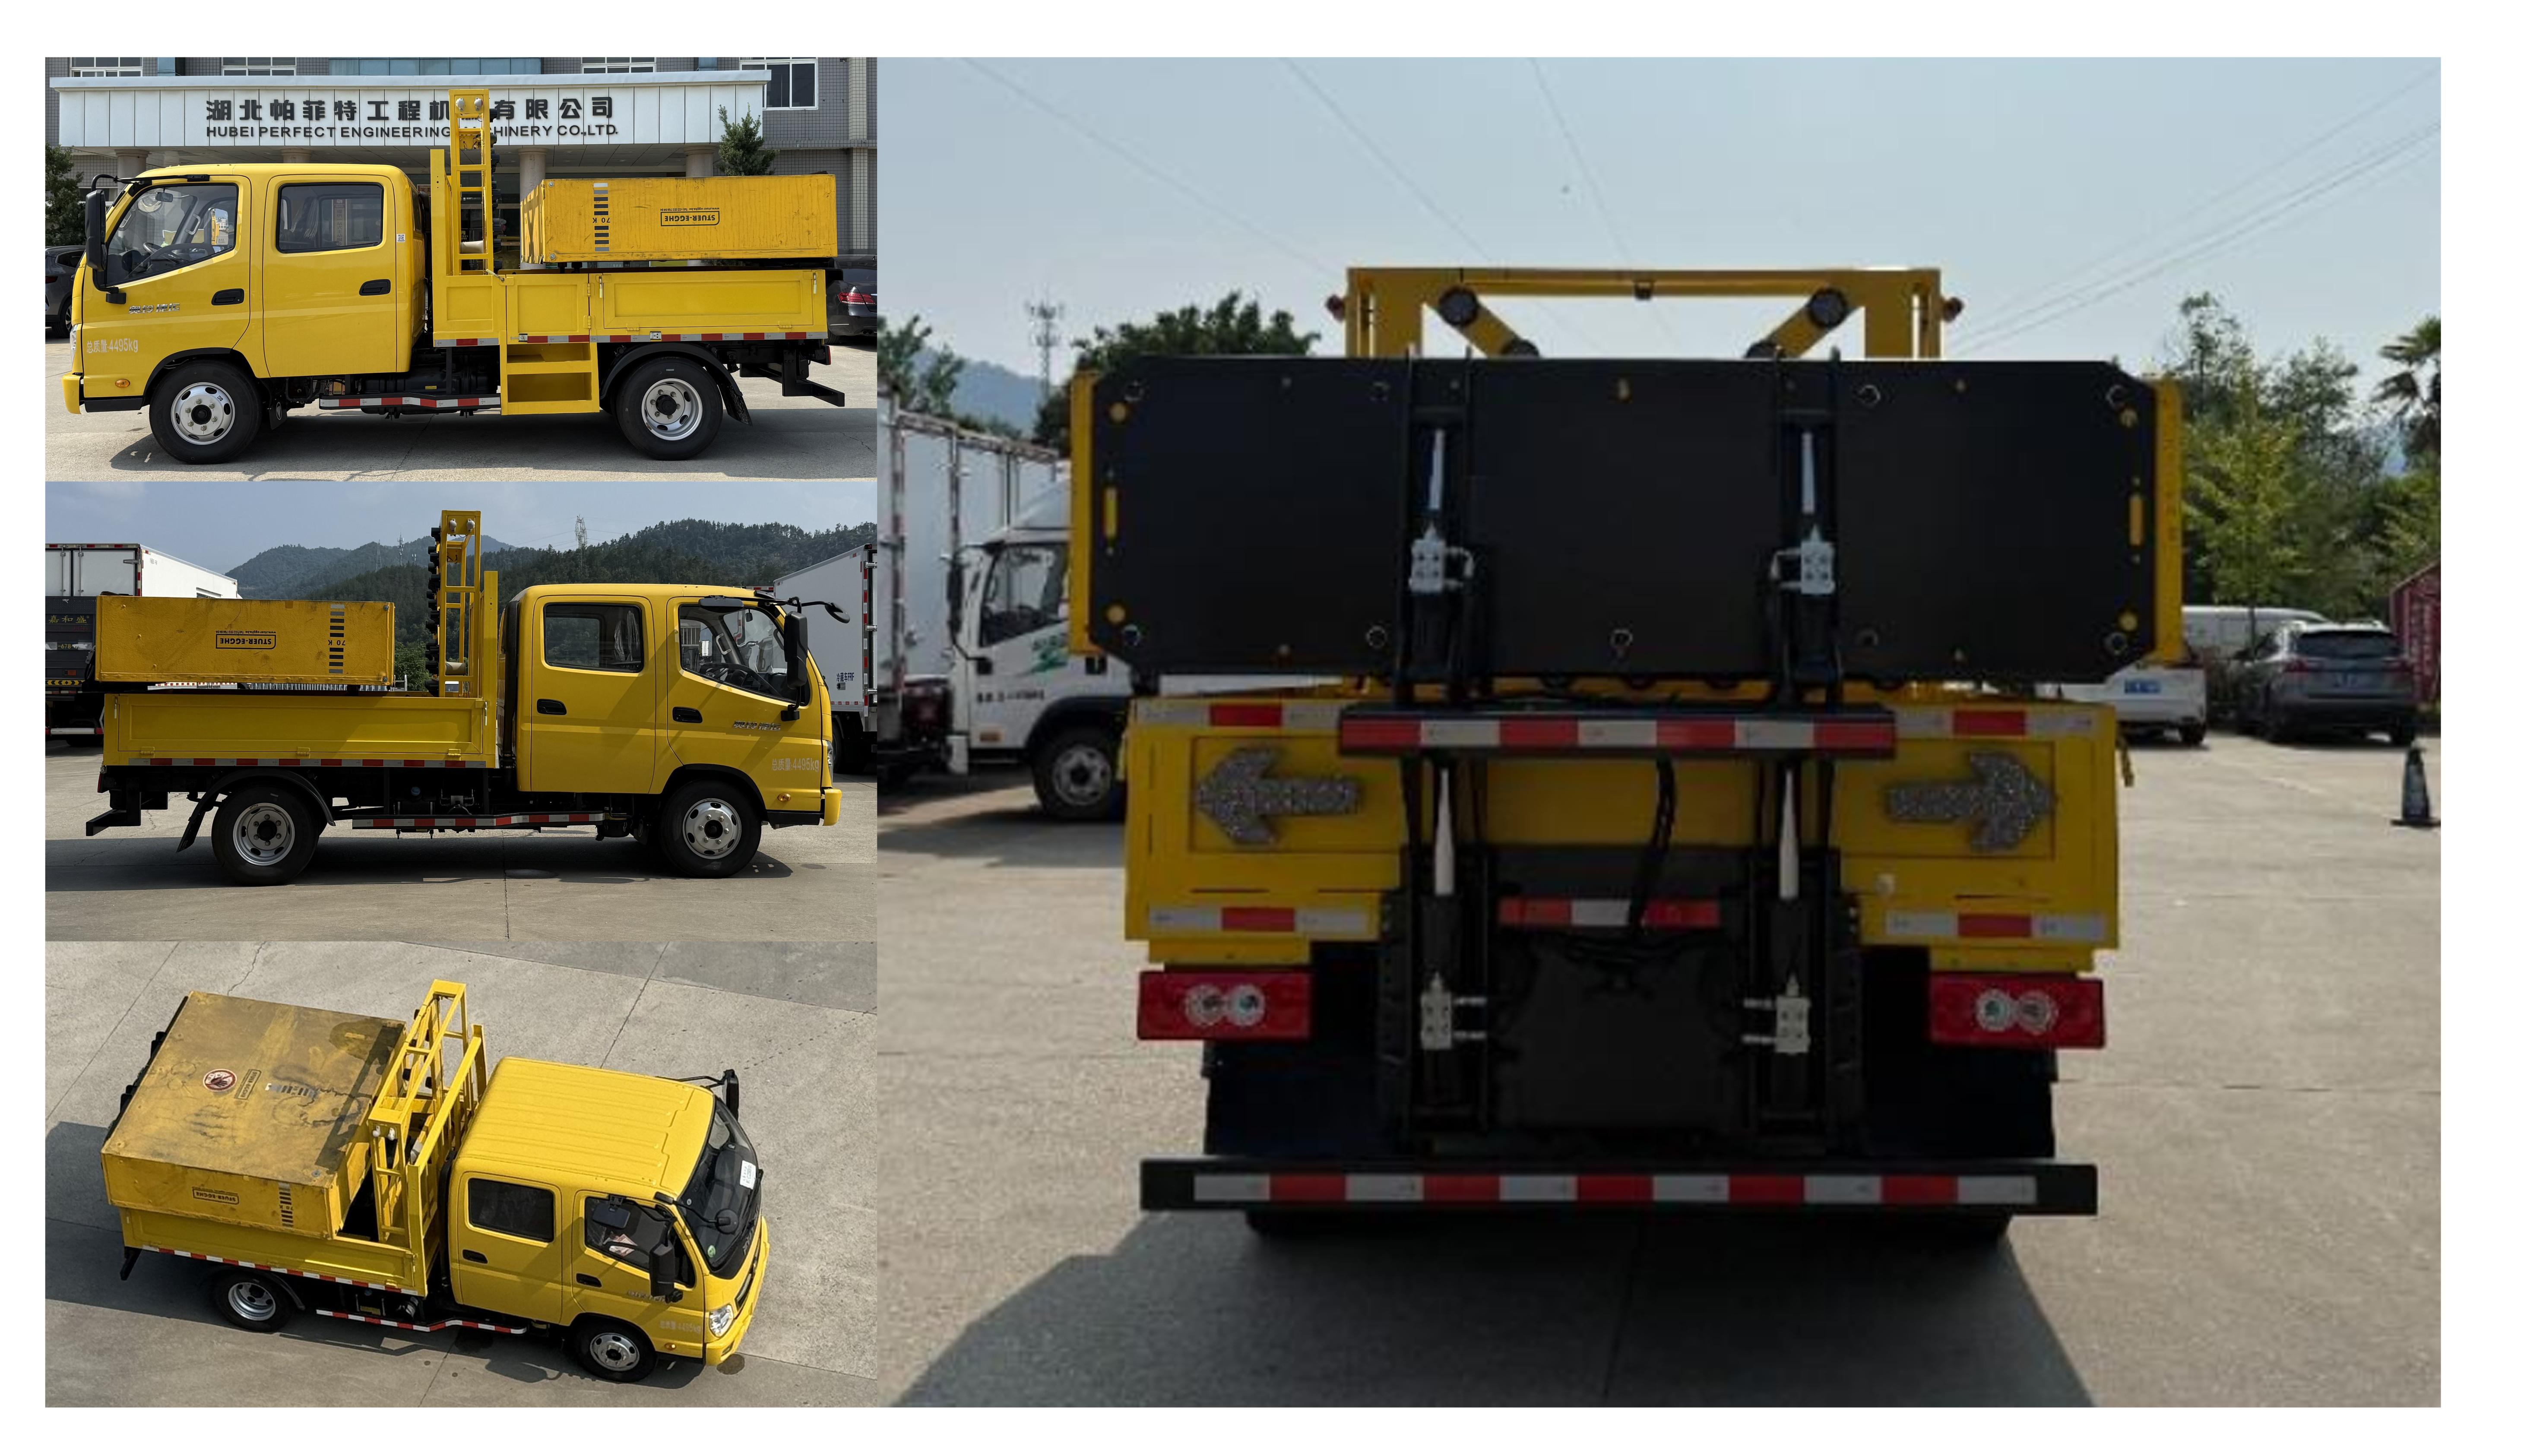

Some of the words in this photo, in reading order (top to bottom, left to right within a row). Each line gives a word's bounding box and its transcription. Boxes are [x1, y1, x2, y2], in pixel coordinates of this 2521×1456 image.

[206, 97, 612, 120] 湖北帕菲特工程机有限公司
[206, 127, 253, 137] HUBEI
[259, 127, 336, 137] PERFECT
[341, 127, 450, 137] ENGINEERING
[462, 125, 552, 137] HINERY
